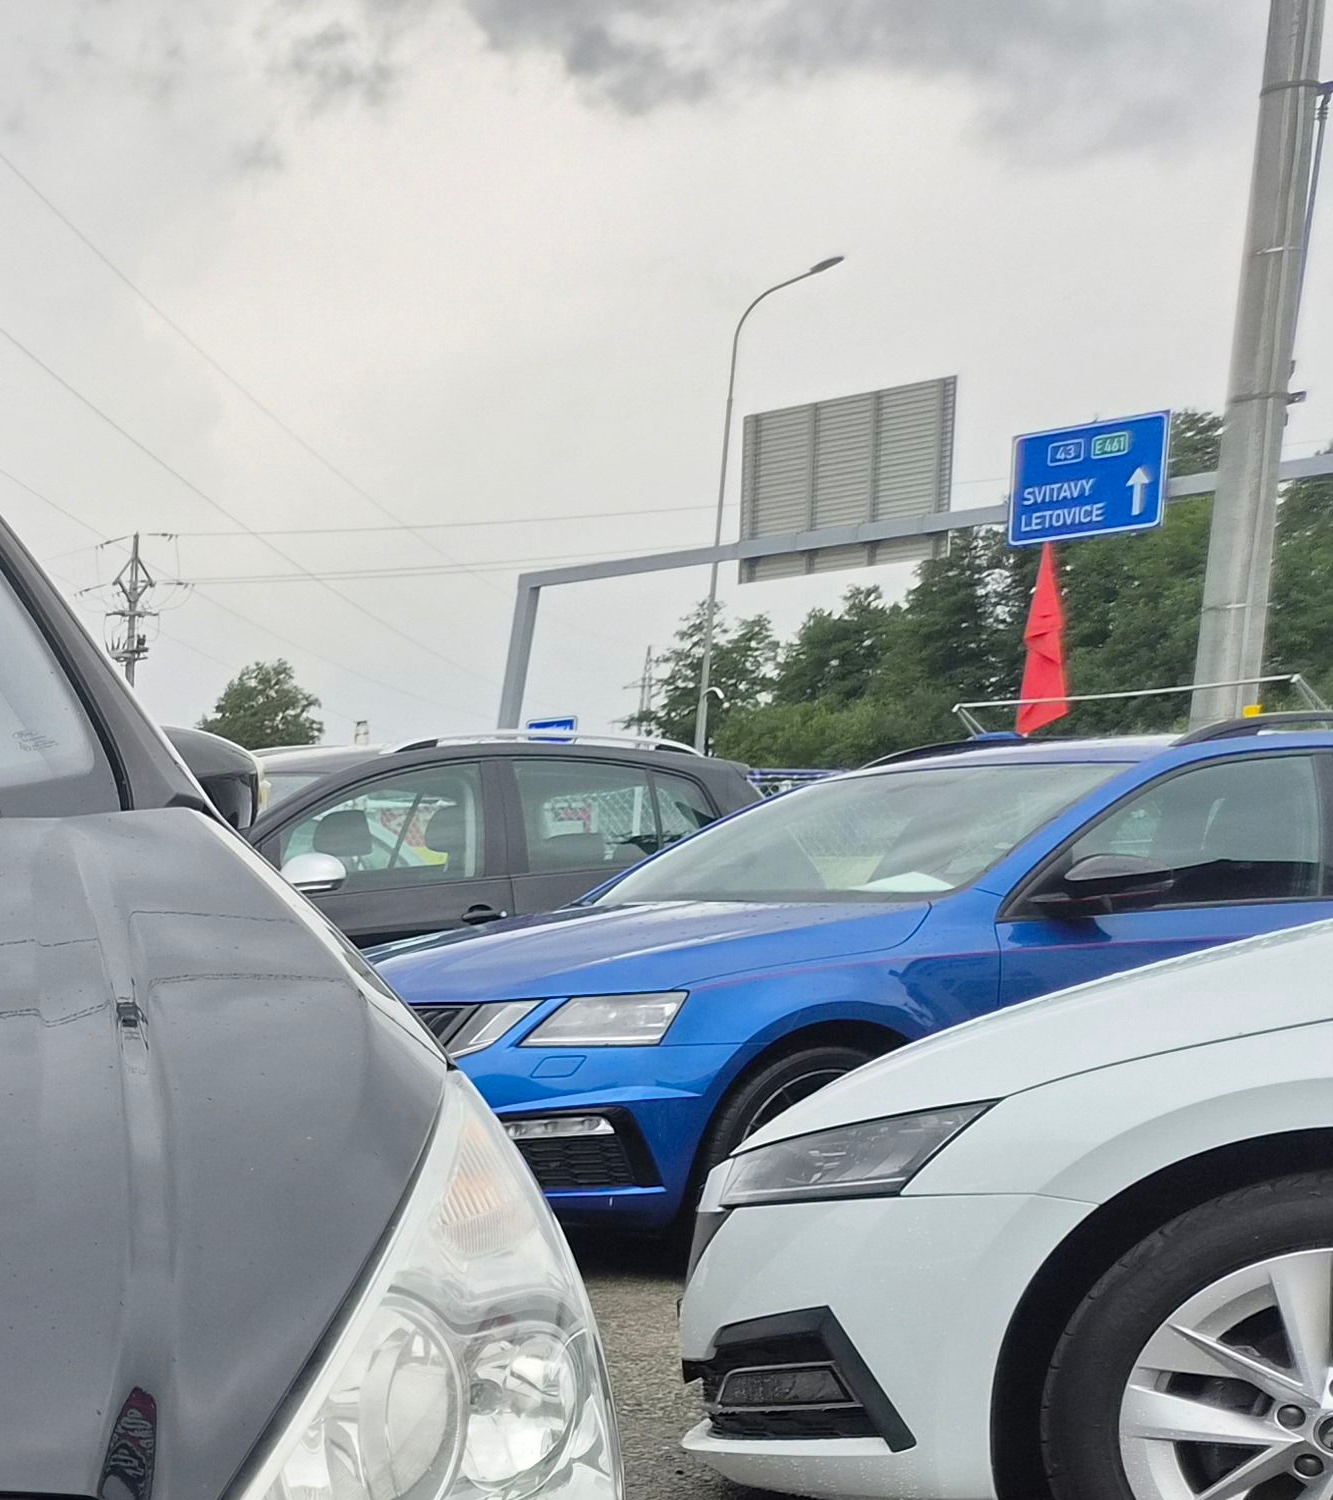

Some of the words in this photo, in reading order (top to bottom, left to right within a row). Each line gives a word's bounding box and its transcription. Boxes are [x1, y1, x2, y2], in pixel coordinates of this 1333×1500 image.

[1056, 445, 1075, 460] 43
[1023, 478, 1097, 506] SVITAVY
[1021, 502, 1108, 532] LETOVICE
